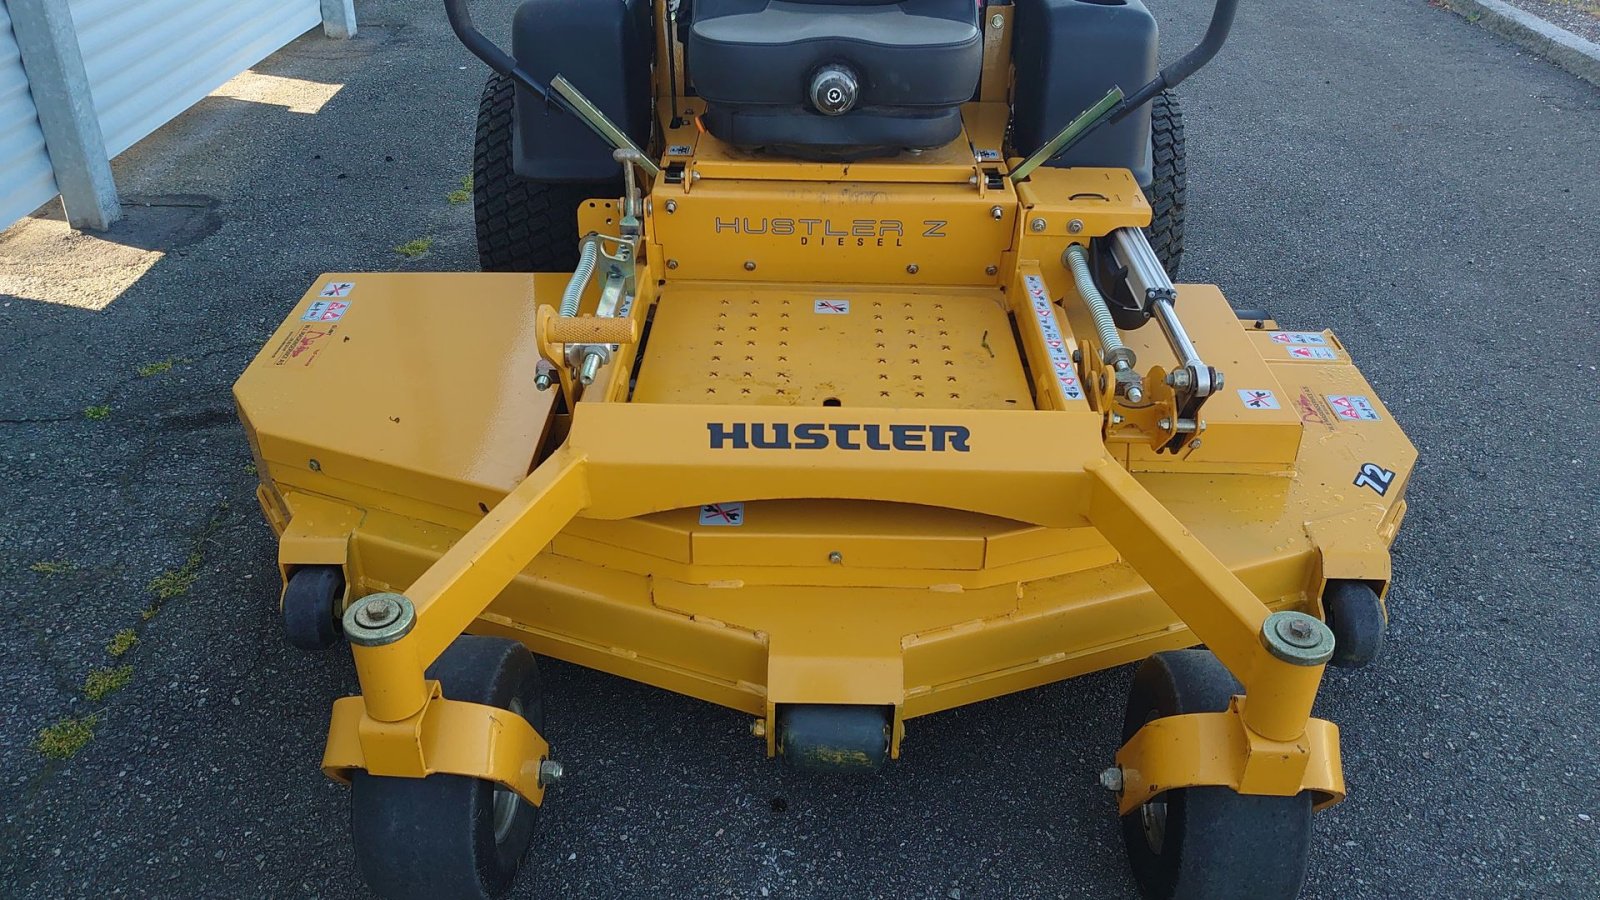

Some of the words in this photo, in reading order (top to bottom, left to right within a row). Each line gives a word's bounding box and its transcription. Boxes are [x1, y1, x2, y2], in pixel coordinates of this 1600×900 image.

[715, 217, 904, 237] HUSTLER
[922, 220, 947, 237] Z
[800, 236, 902, 247] DIESEL
[706, 422, 971, 452] HUSTLER
[1353, 463, 1396, 497] 72
